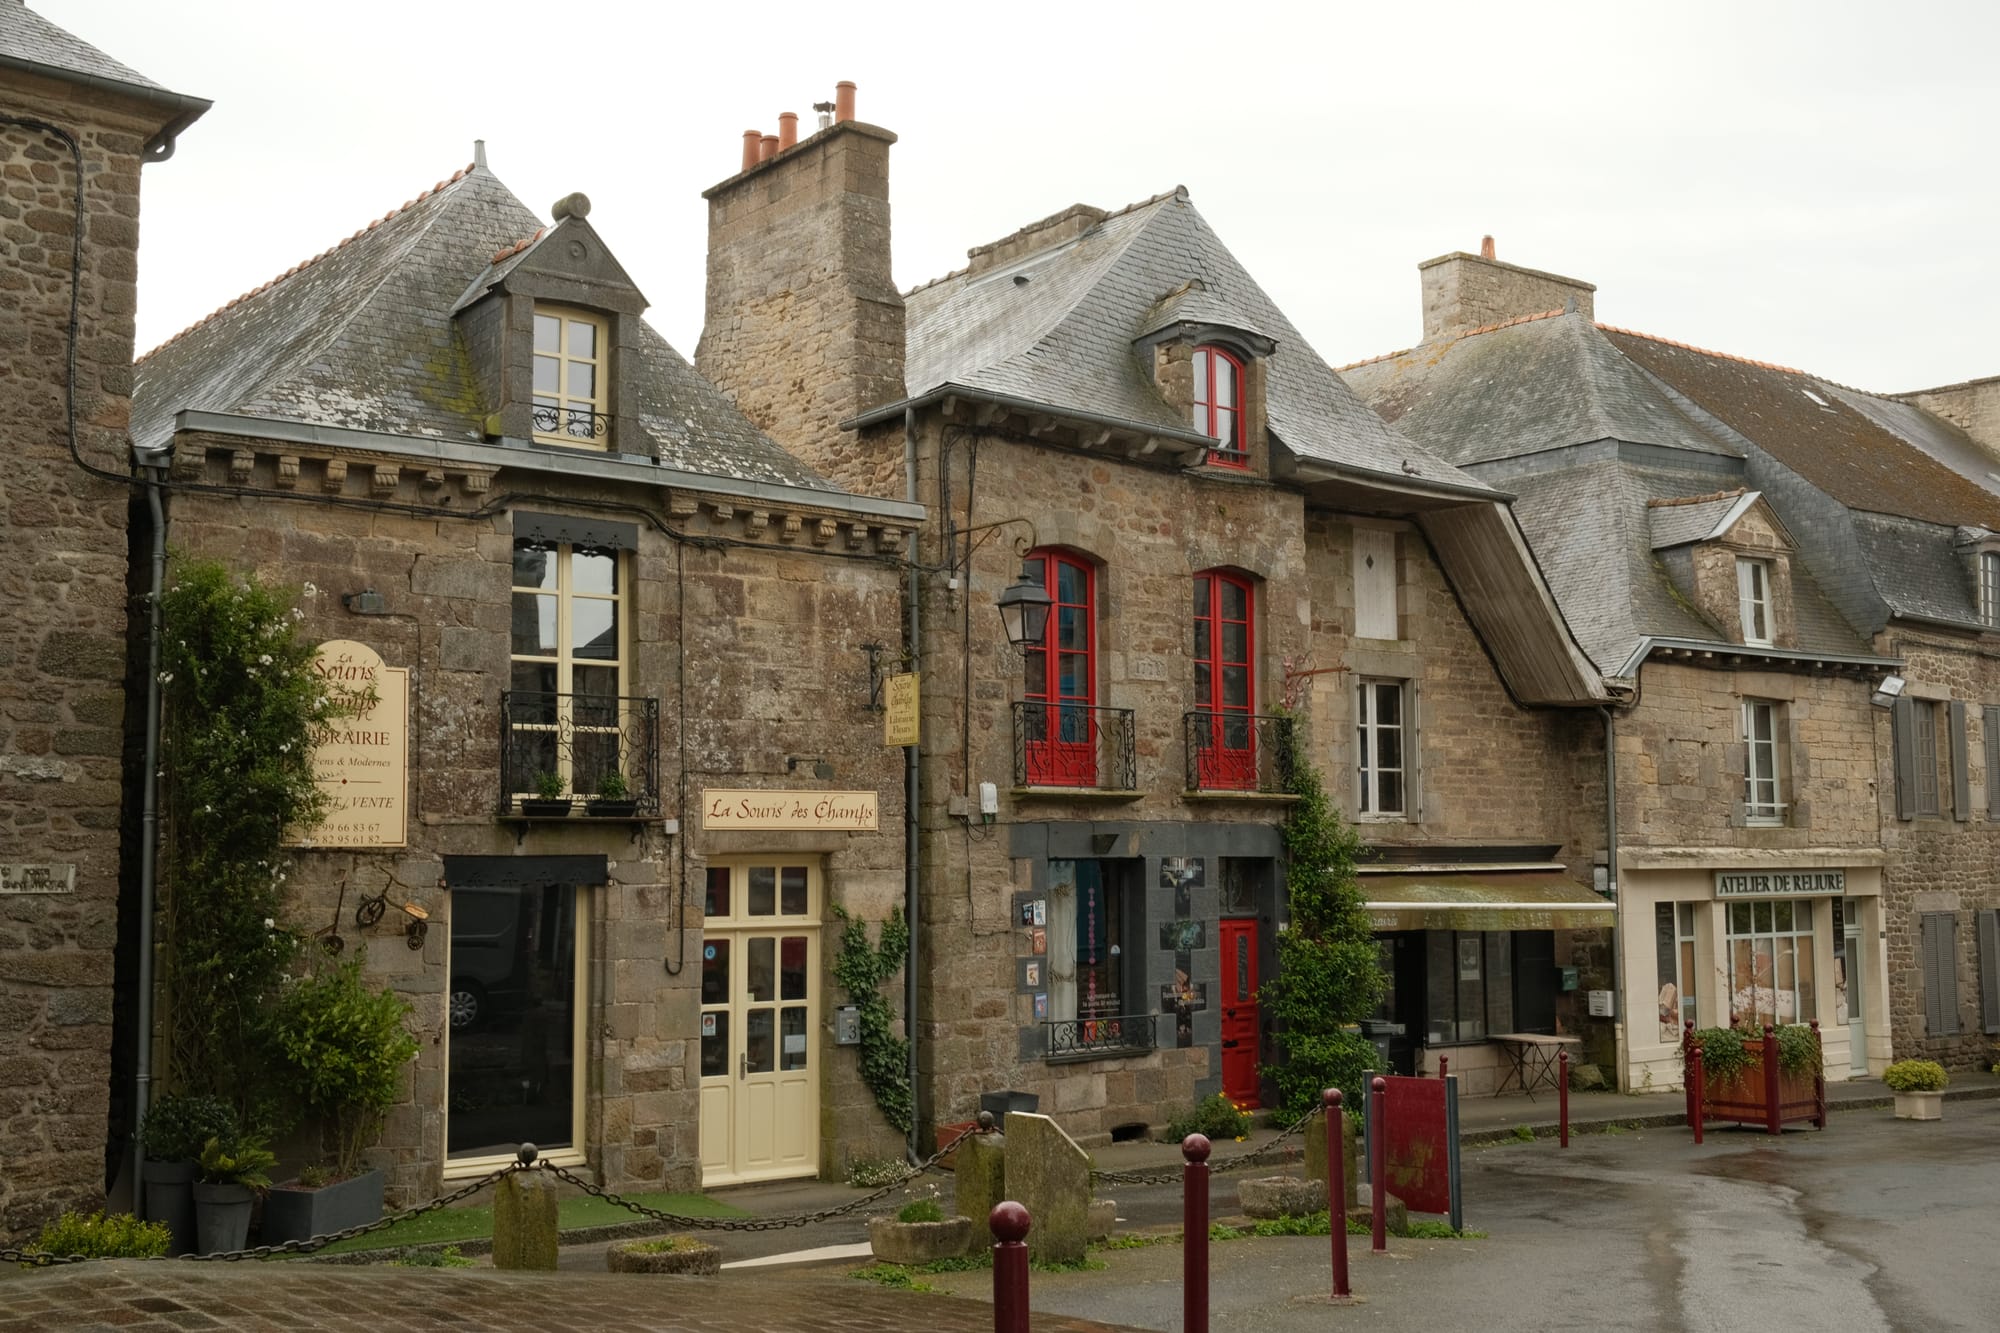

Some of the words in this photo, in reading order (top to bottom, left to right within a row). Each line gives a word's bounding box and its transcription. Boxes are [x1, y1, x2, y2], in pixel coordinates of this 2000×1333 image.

[337, 653, 353, 663] La
[316, 658, 380, 680] Souris
[336, 758, 345, 766] &
[348, 758, 391, 767] Modernes
[352, 796, 394, 809] VENTE
[707, 798, 732, 818] La
[736, 798, 786, 819] Souris
[791, 800, 808, 819] des
[814, 795, 874, 827] Champs
[322, 823, 335, 833] 99
[337, 823, 350, 833] 66
[352, 823, 365, 833] 83
[368, 823, 380, 833] 67
[322, 835, 335, 845] 82
[337, 835, 350, 845] 95
[352, 835, 364, 845] 61
[368, 835, 380, 845] 82
[1719, 875, 1770, 894] ATELIER
[1773, 874, 1791, 892] DE
[1792, 873, 1844, 892] RELIURE
[848, 1024, 857, 1040] 3
